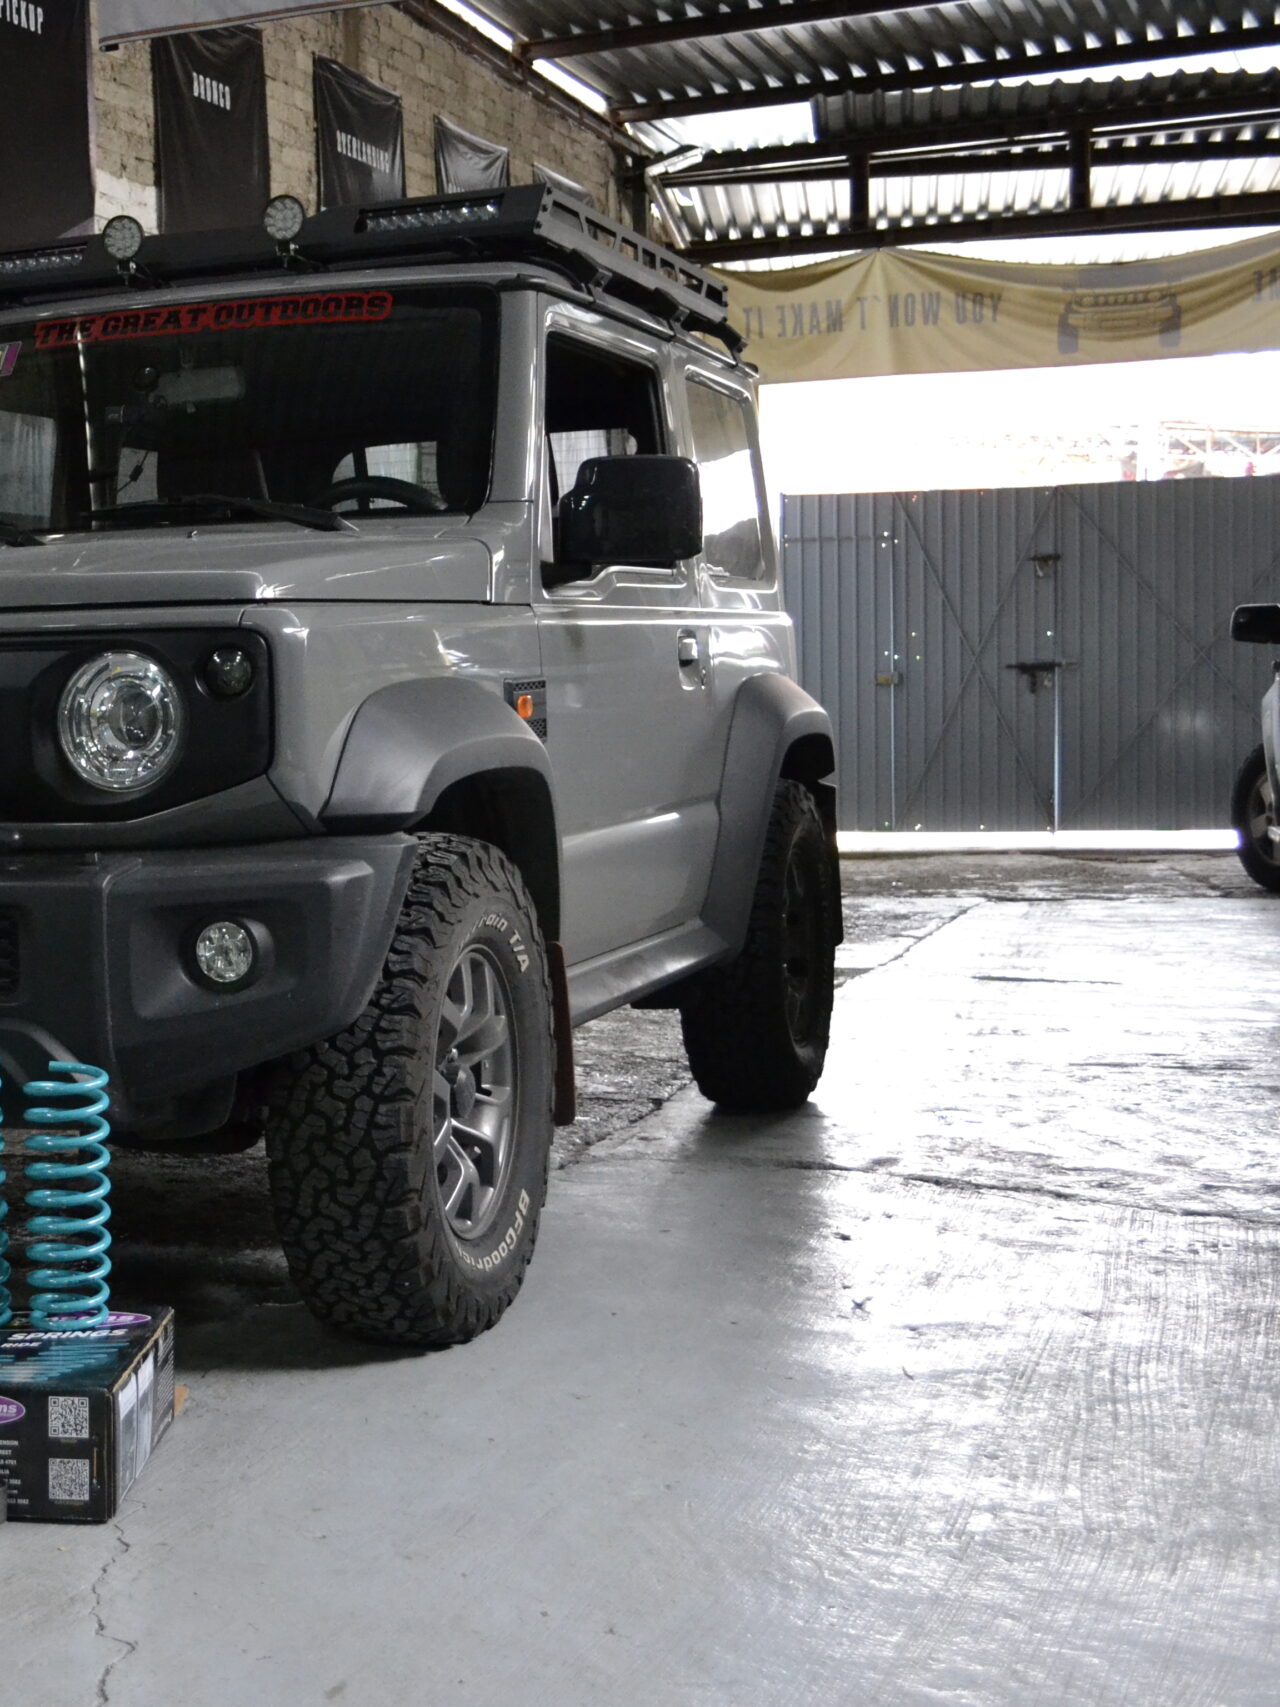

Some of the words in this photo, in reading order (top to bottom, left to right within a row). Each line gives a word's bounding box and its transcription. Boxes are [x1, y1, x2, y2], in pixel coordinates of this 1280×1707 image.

[192, 71, 231, 111] BRONCO
[336, 129, 390, 174] OVERLANDING
[37, 318, 96, 347] THE
[100, 306, 208, 335] GREAT
[212, 295, 392, 329] OUTDOORS
[509, 929, 530, 973] T/A
[7, 1328, 129, 1341] SPRINGS
